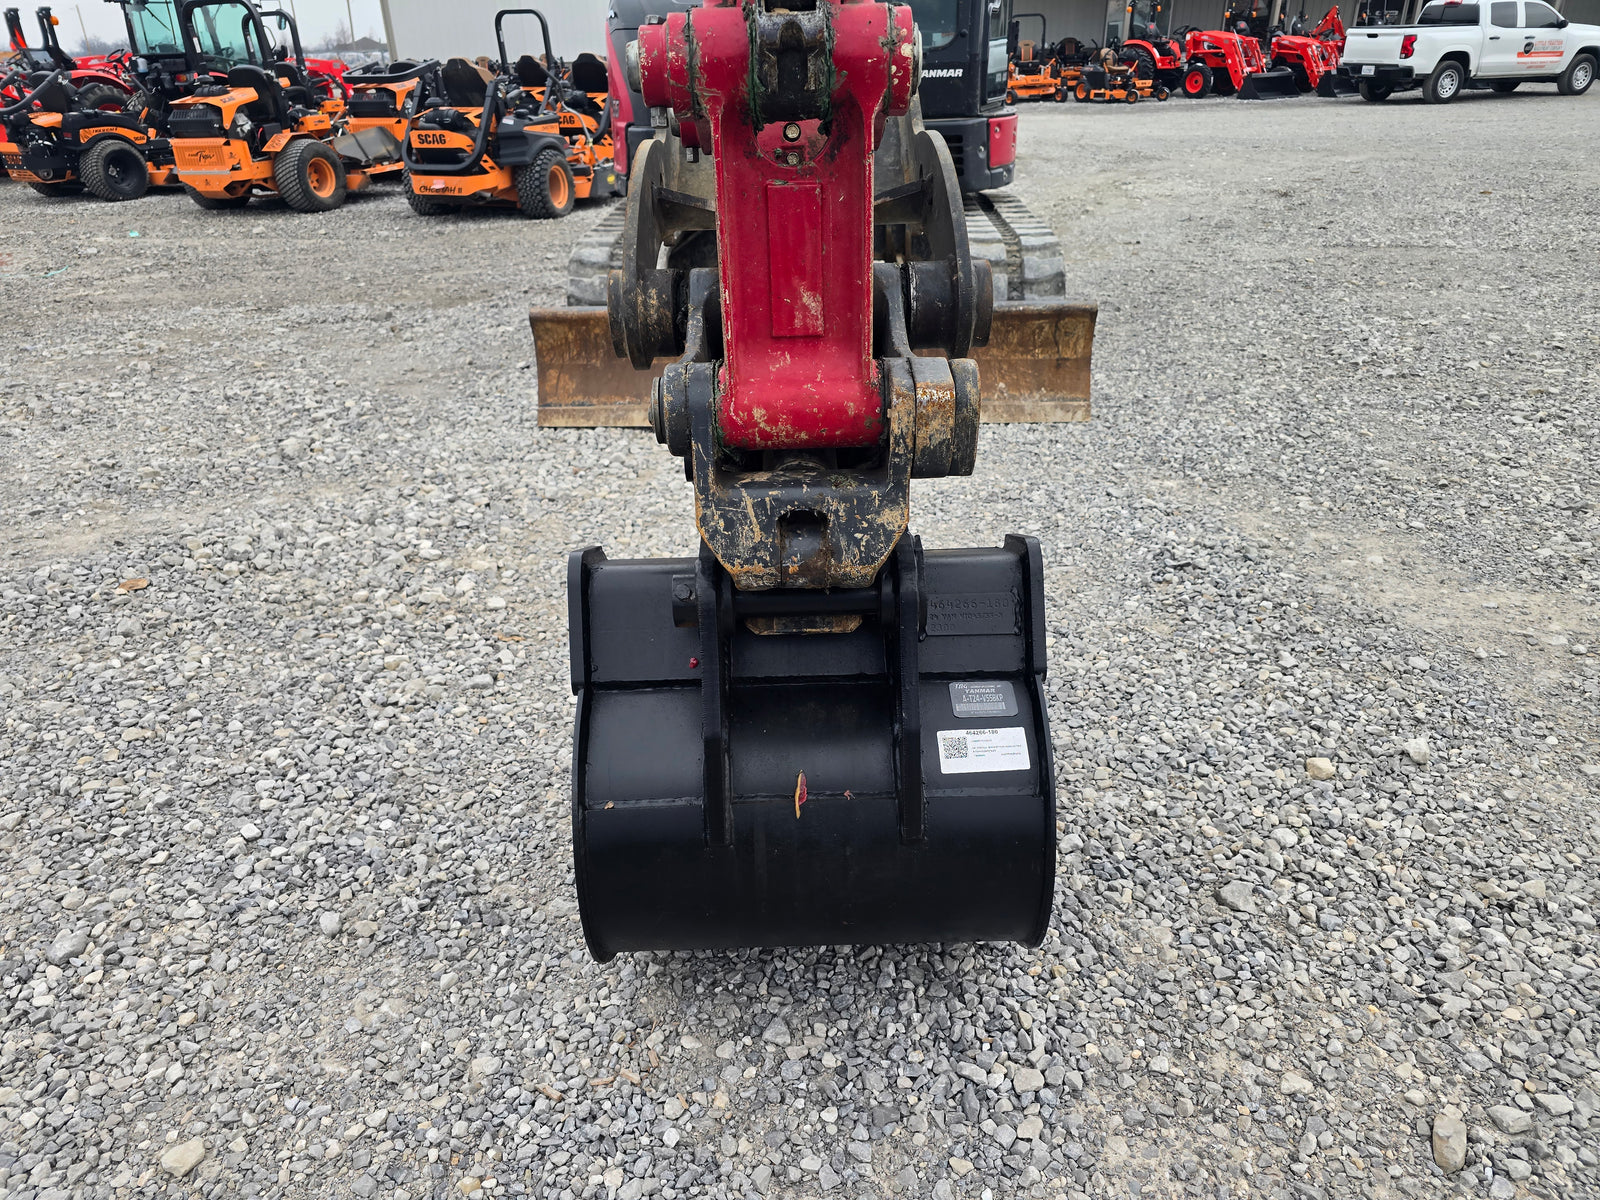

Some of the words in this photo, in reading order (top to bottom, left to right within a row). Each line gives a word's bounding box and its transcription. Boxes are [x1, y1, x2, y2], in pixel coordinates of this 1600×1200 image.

[921, 68, 964, 78] ANMAR
[558, 115, 576, 125] CAG
[417, 133, 447, 145] SCAG
